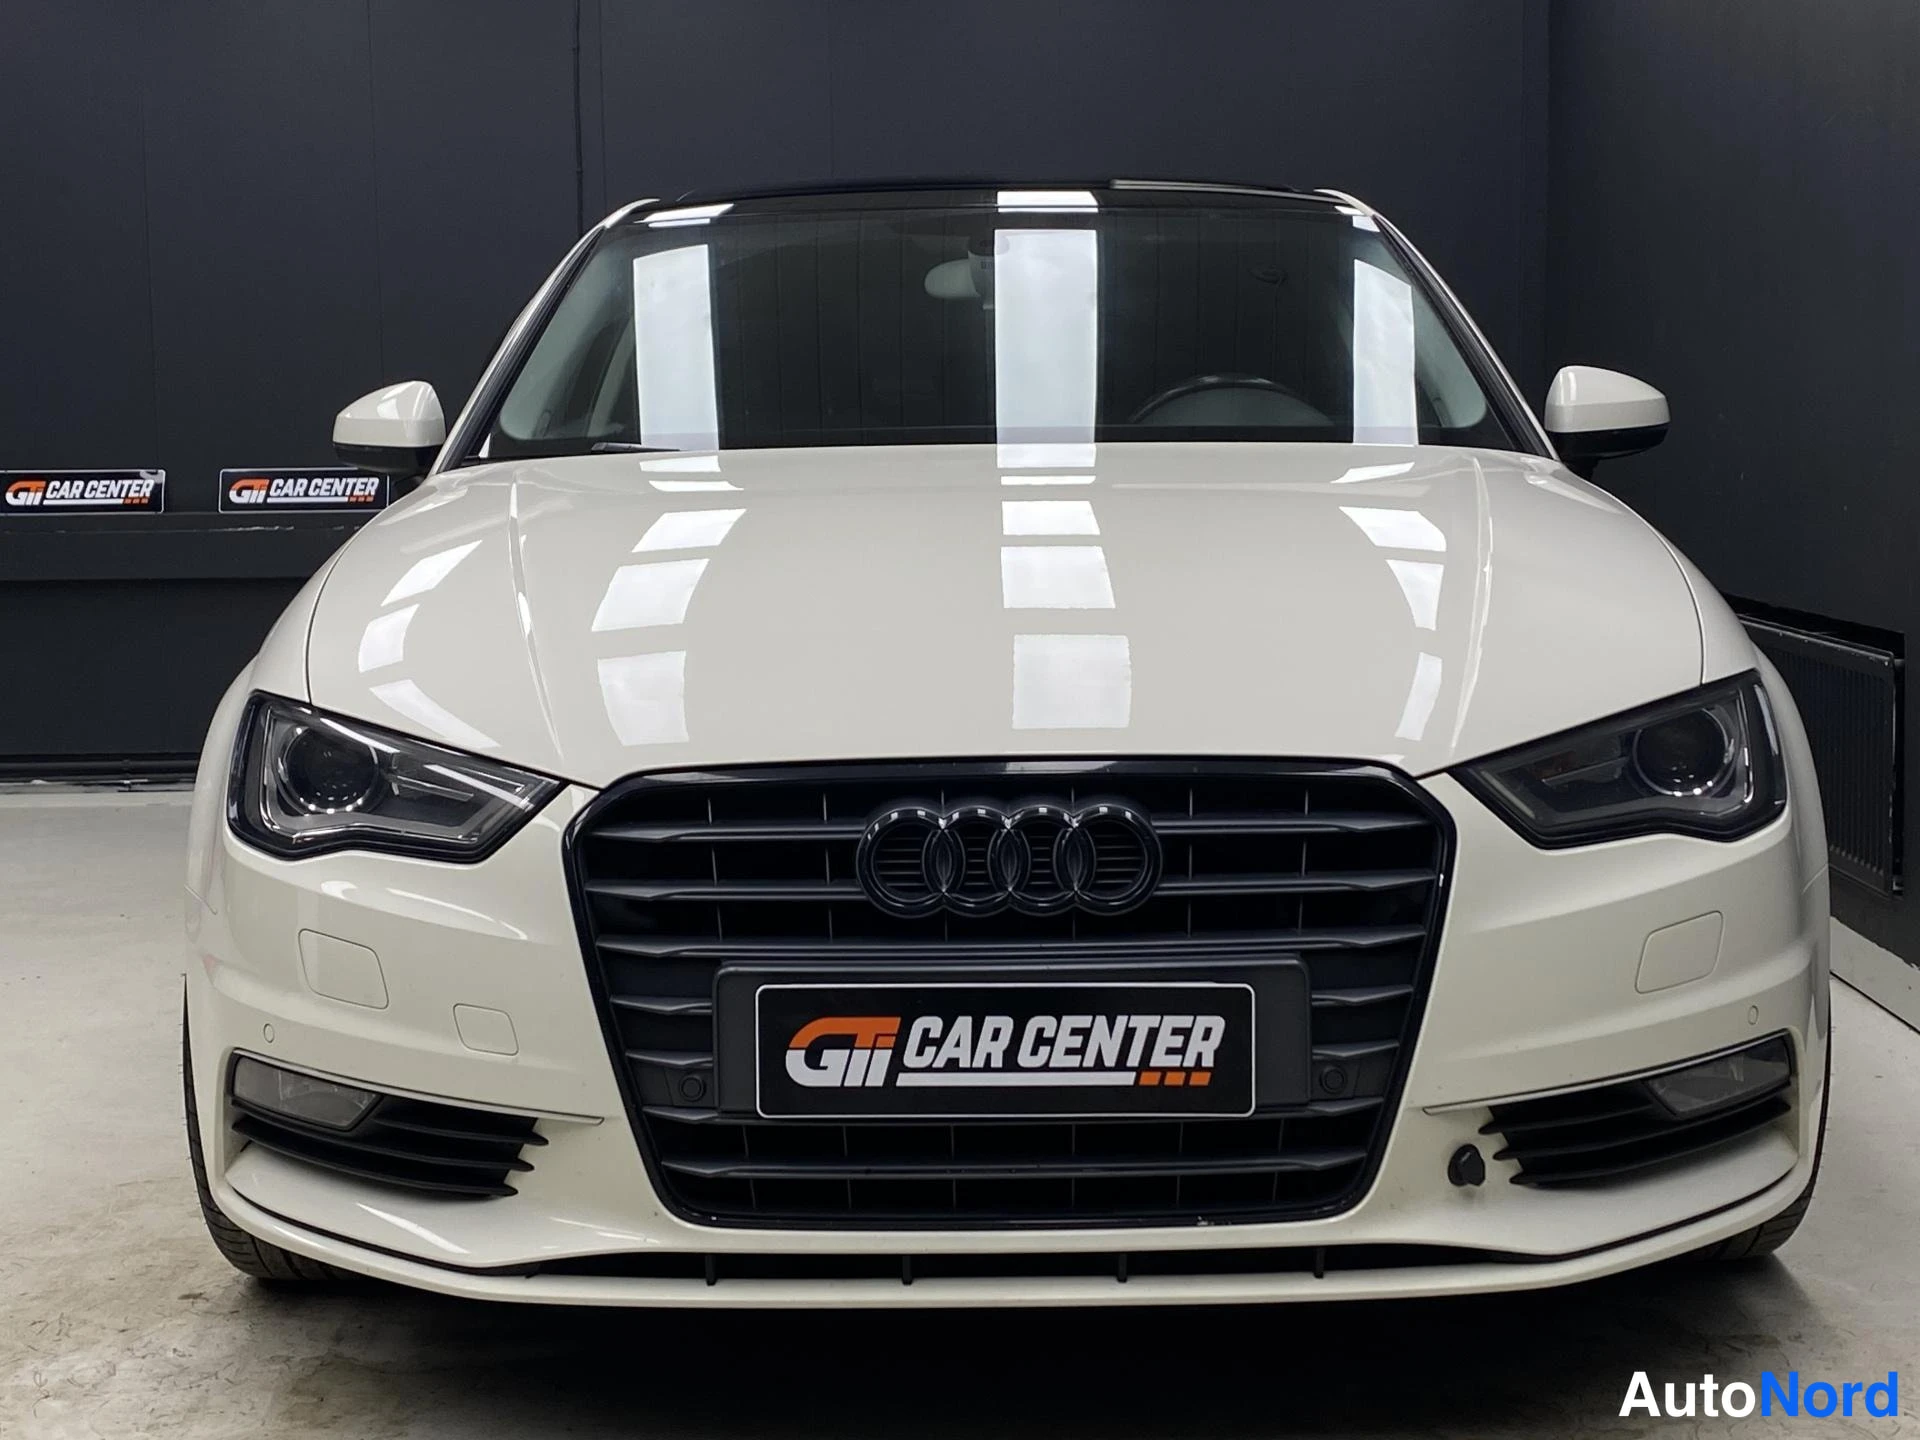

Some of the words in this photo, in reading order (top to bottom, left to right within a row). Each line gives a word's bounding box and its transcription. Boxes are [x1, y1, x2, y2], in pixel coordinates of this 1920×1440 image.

[46, 480, 83, 499] CAR
[84, 479, 154, 498] CENTER
[270, 478, 307, 497] CAR
[308, 477, 379, 497] CENTER
[903, 1015, 1014, 1068] CAR
[1016, 1015, 1226, 1068] CENTER
